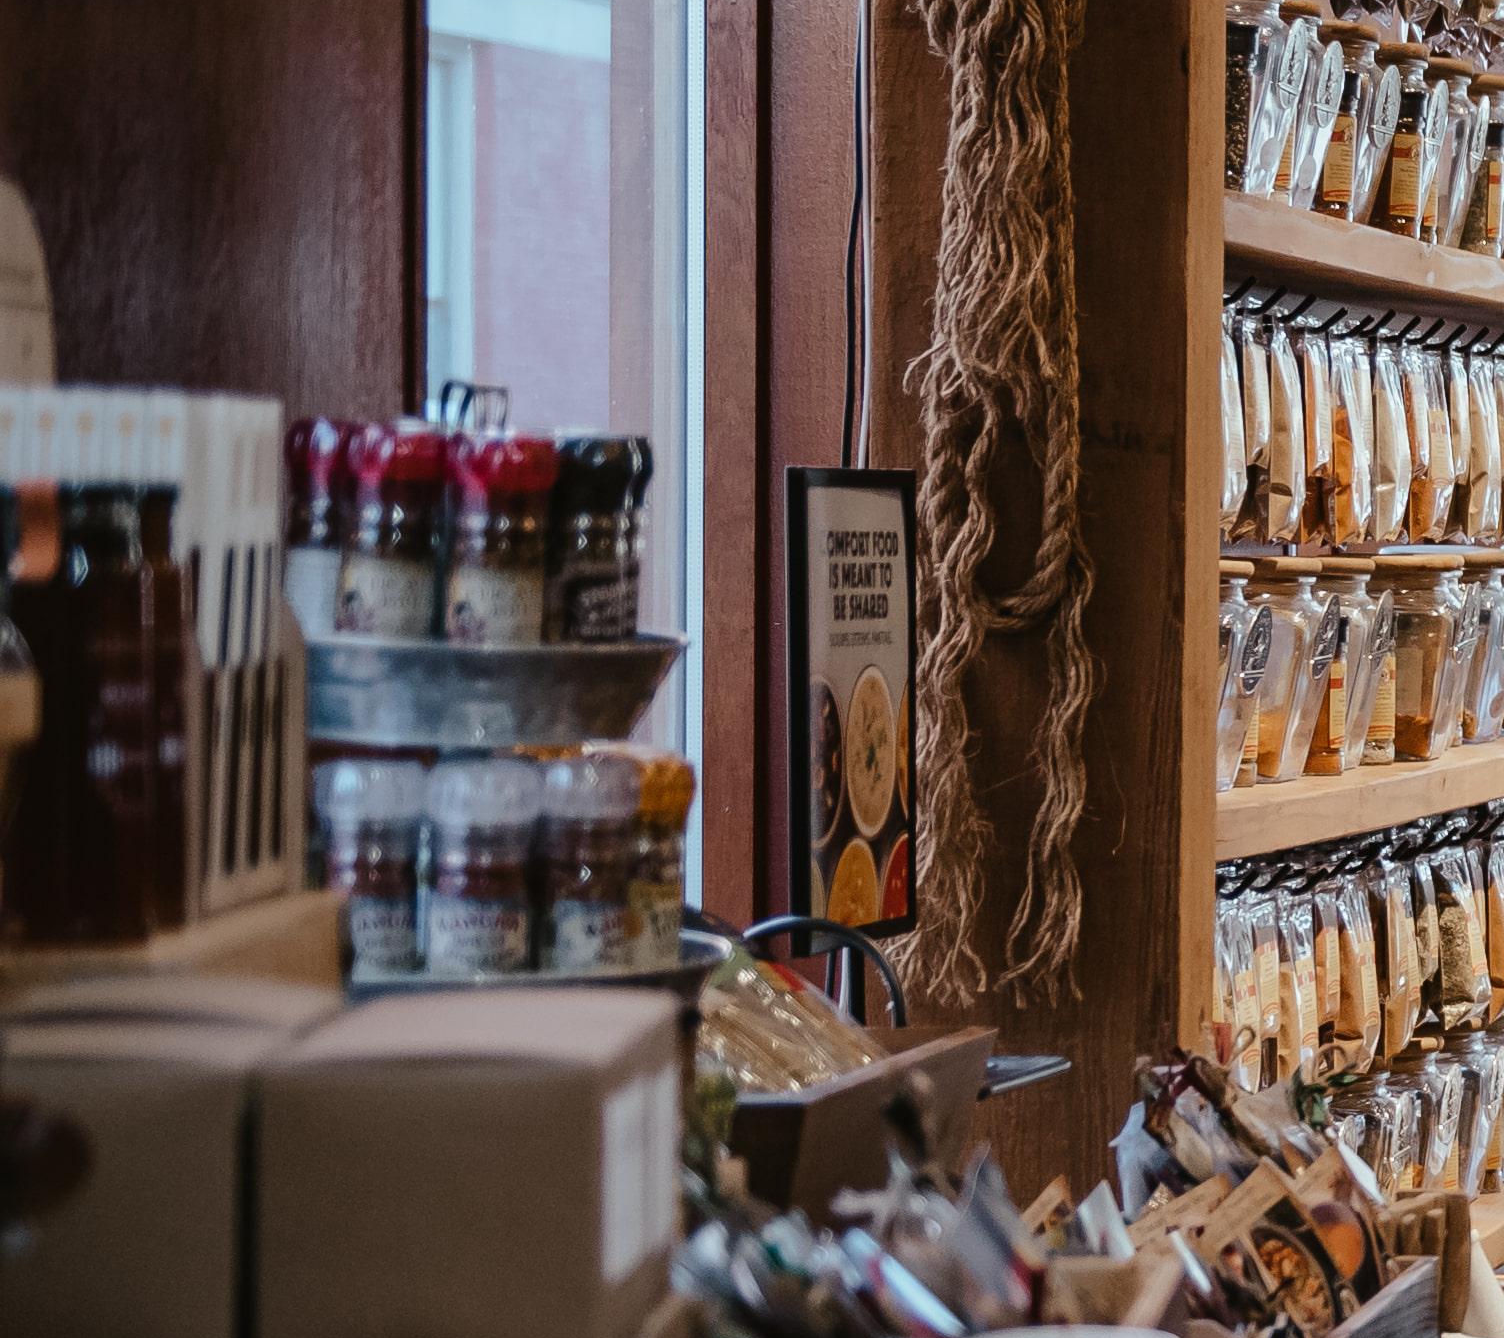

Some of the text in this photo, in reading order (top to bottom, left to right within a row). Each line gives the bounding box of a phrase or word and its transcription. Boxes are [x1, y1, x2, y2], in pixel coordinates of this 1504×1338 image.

[826, 529, 899, 558] OMFORT FOOD
[828, 562, 893, 589] IS MEANT TO
[833, 593, 889, 621] BE SHARED
